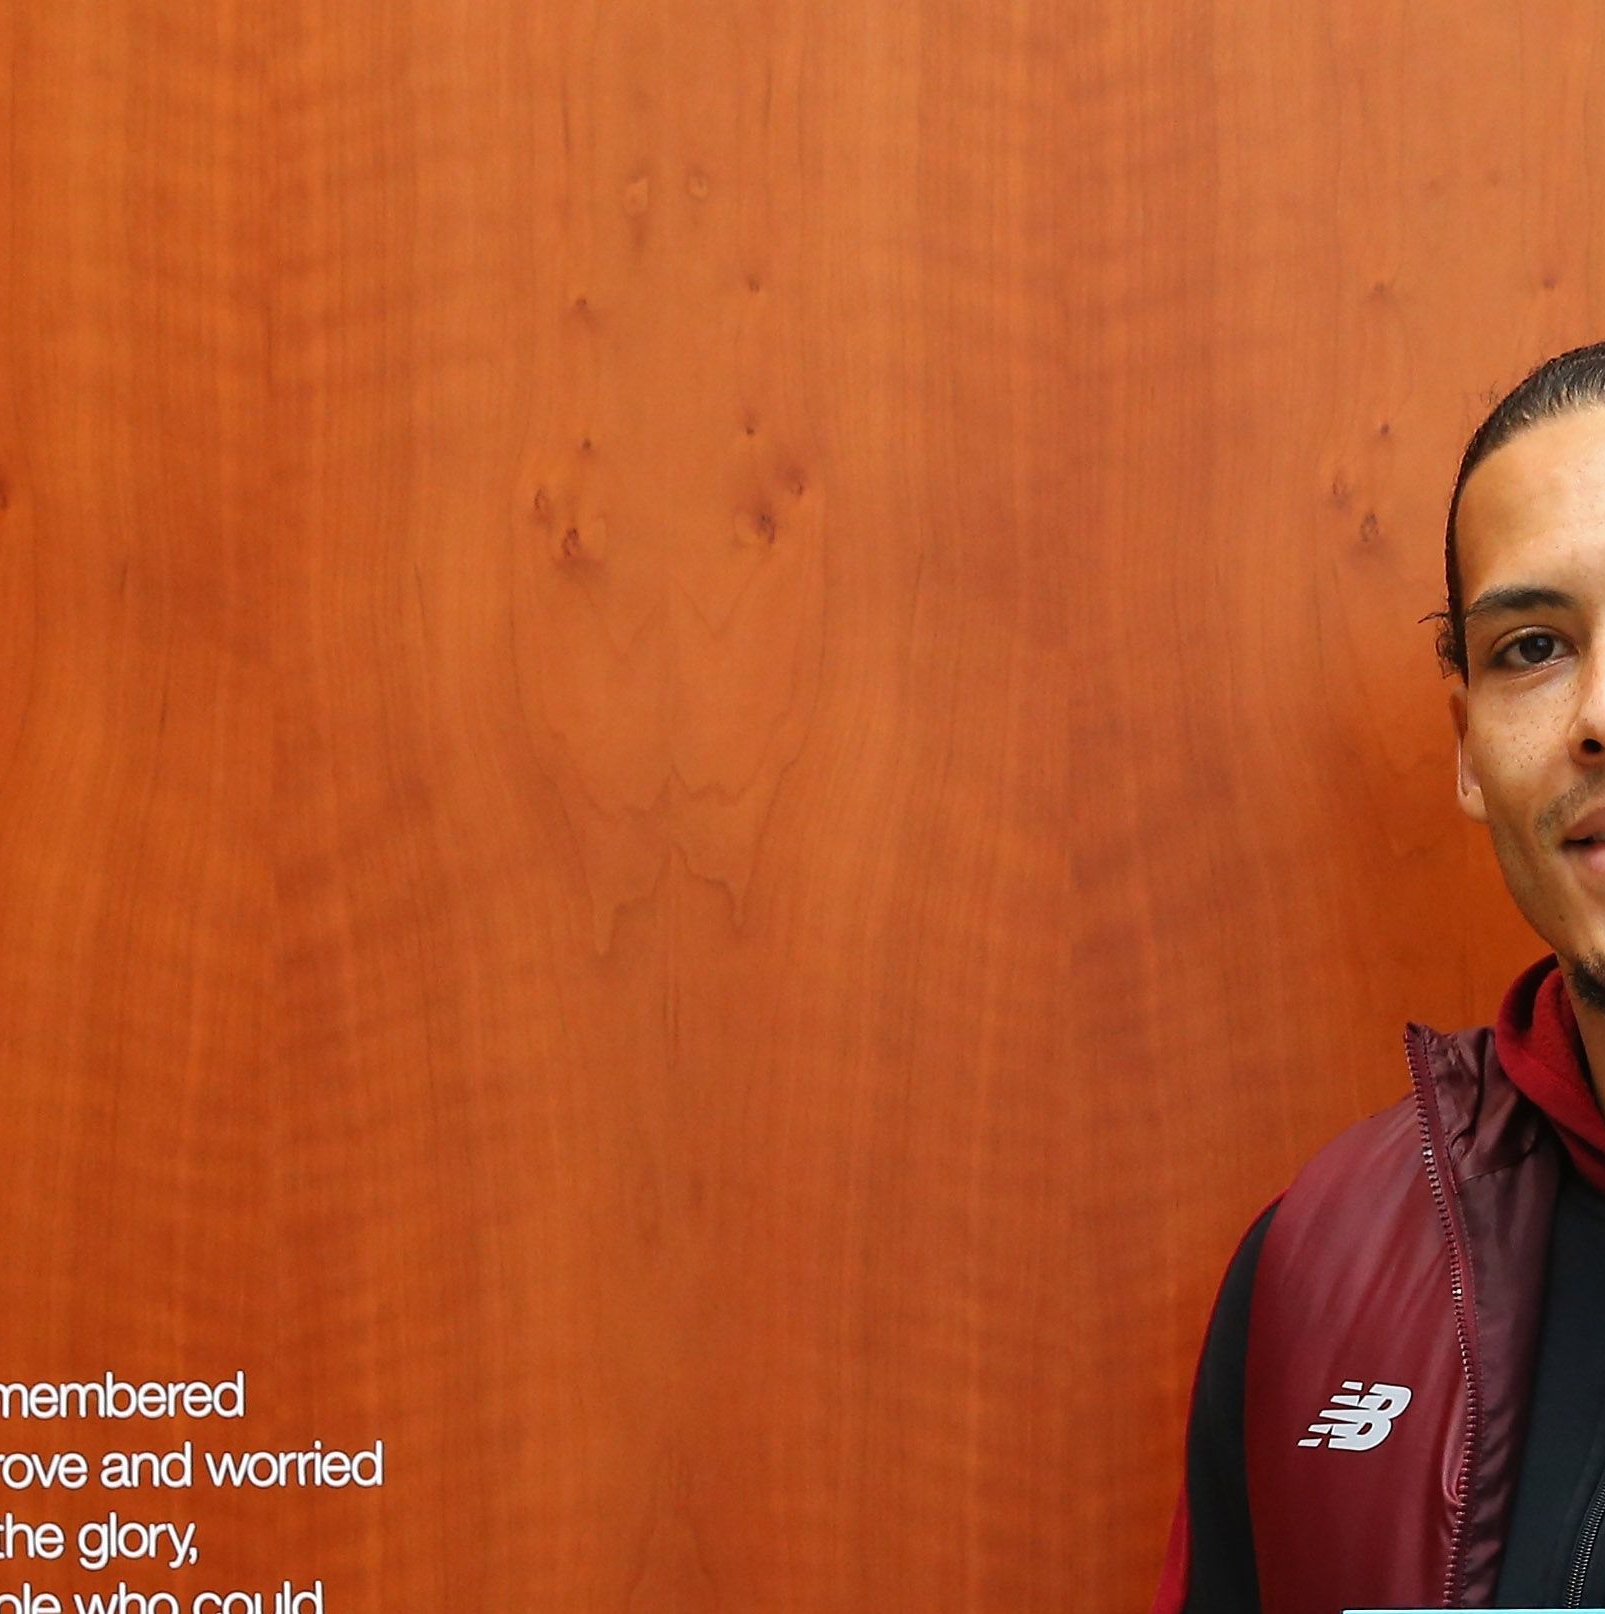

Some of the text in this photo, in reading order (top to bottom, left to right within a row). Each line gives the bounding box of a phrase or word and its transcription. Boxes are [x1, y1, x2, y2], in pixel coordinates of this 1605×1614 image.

[102, 1443, 192, 1489] and
[206, 1441, 383, 1488] worried
[79, 1513, 198, 1571] glory,
